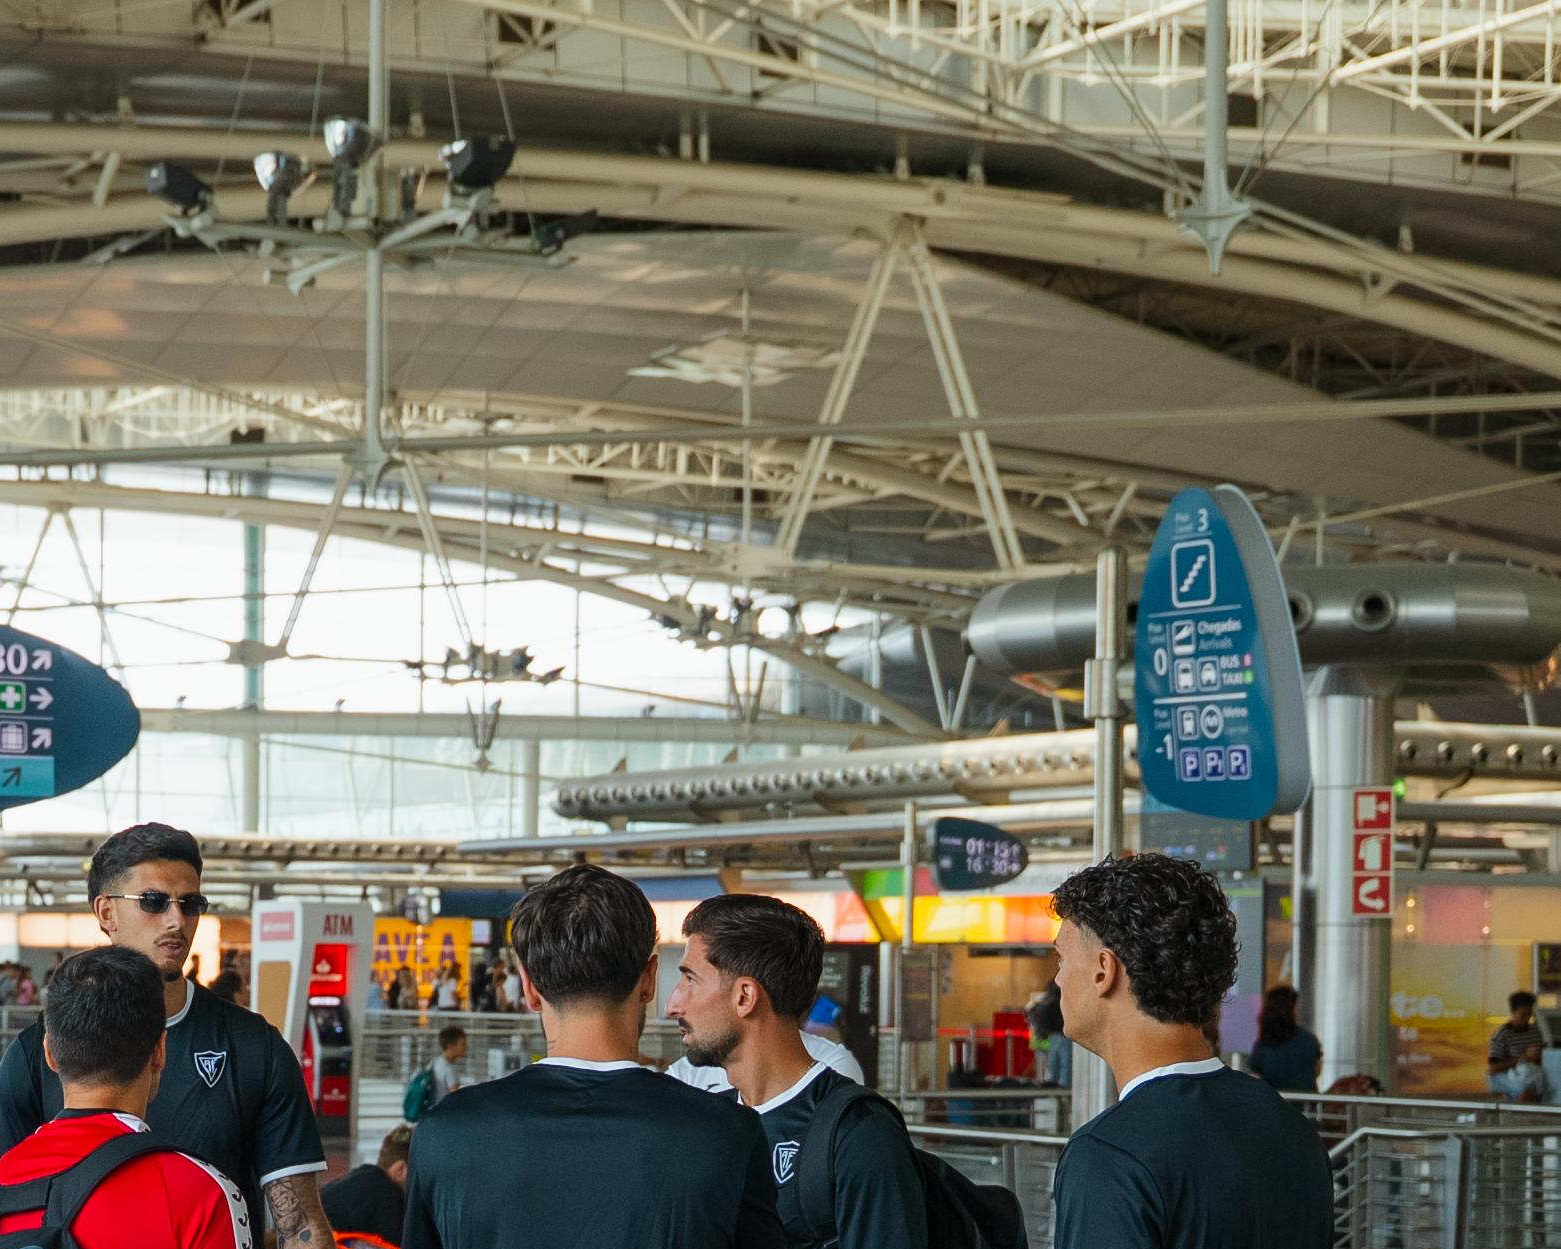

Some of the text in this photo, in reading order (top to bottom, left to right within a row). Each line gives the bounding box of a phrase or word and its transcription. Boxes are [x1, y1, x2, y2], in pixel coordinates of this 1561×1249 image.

[1198, 508, 1208, 532] 3
[1154, 648, 1168, 676] 0
[323, 914, 354, 937] ATM
[374, 933, 430, 965] AVE
